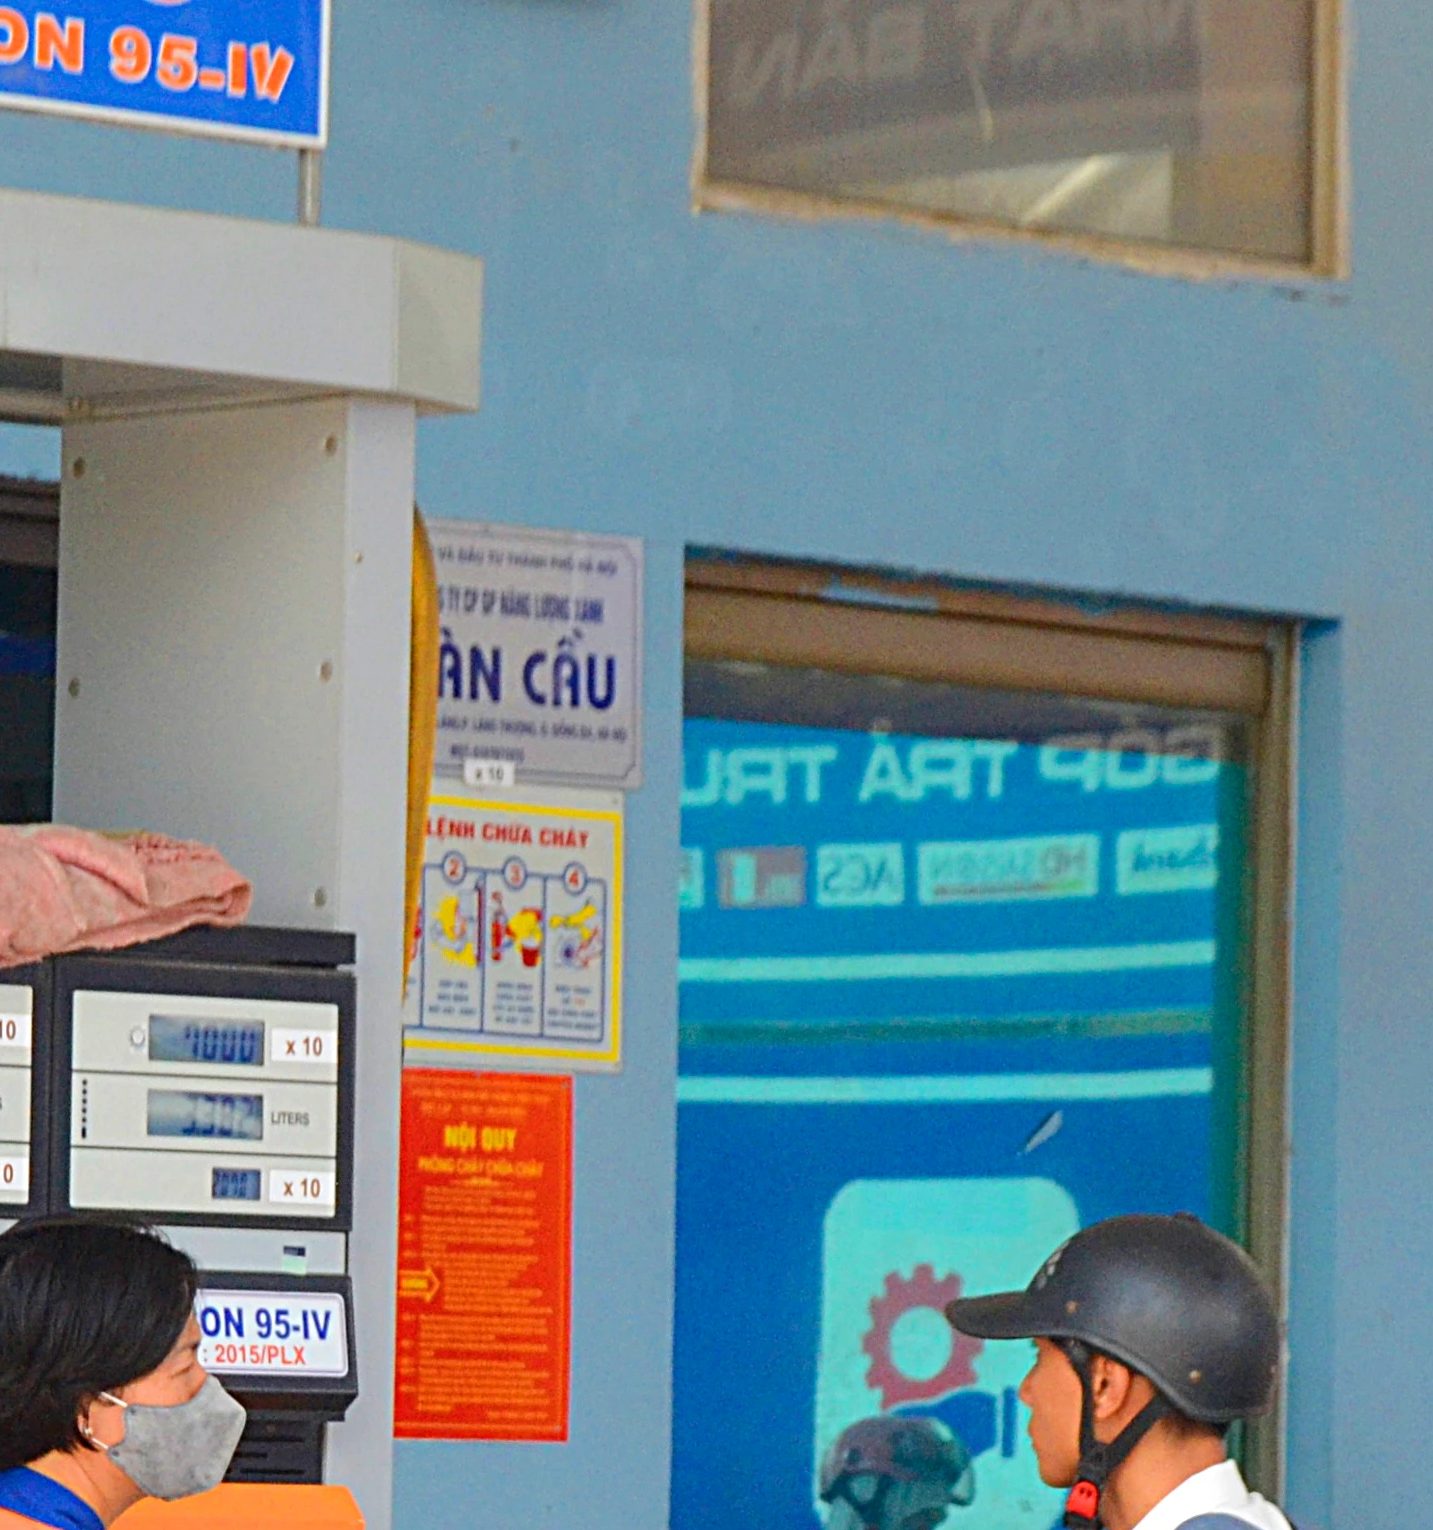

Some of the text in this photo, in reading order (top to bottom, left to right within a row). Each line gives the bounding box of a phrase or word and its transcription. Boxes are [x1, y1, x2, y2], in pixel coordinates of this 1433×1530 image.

[109, 25, 295, 104] 95-IV
[523, 628, 615, 710] CẦU
[482, 820, 533, 846] CHỮA
[539, 823, 589, 849] CHÁY
[449, 859, 579, 886] 2 3 4
[285, 1037, 323, 1057] x 10
[271, 1111, 310, 1126] LITERS
[283, 1178, 321, 1198] x 10
[255, 1307, 331, 1340] 95-IV
[214, 1343, 307, 1366] 2015/PLX
